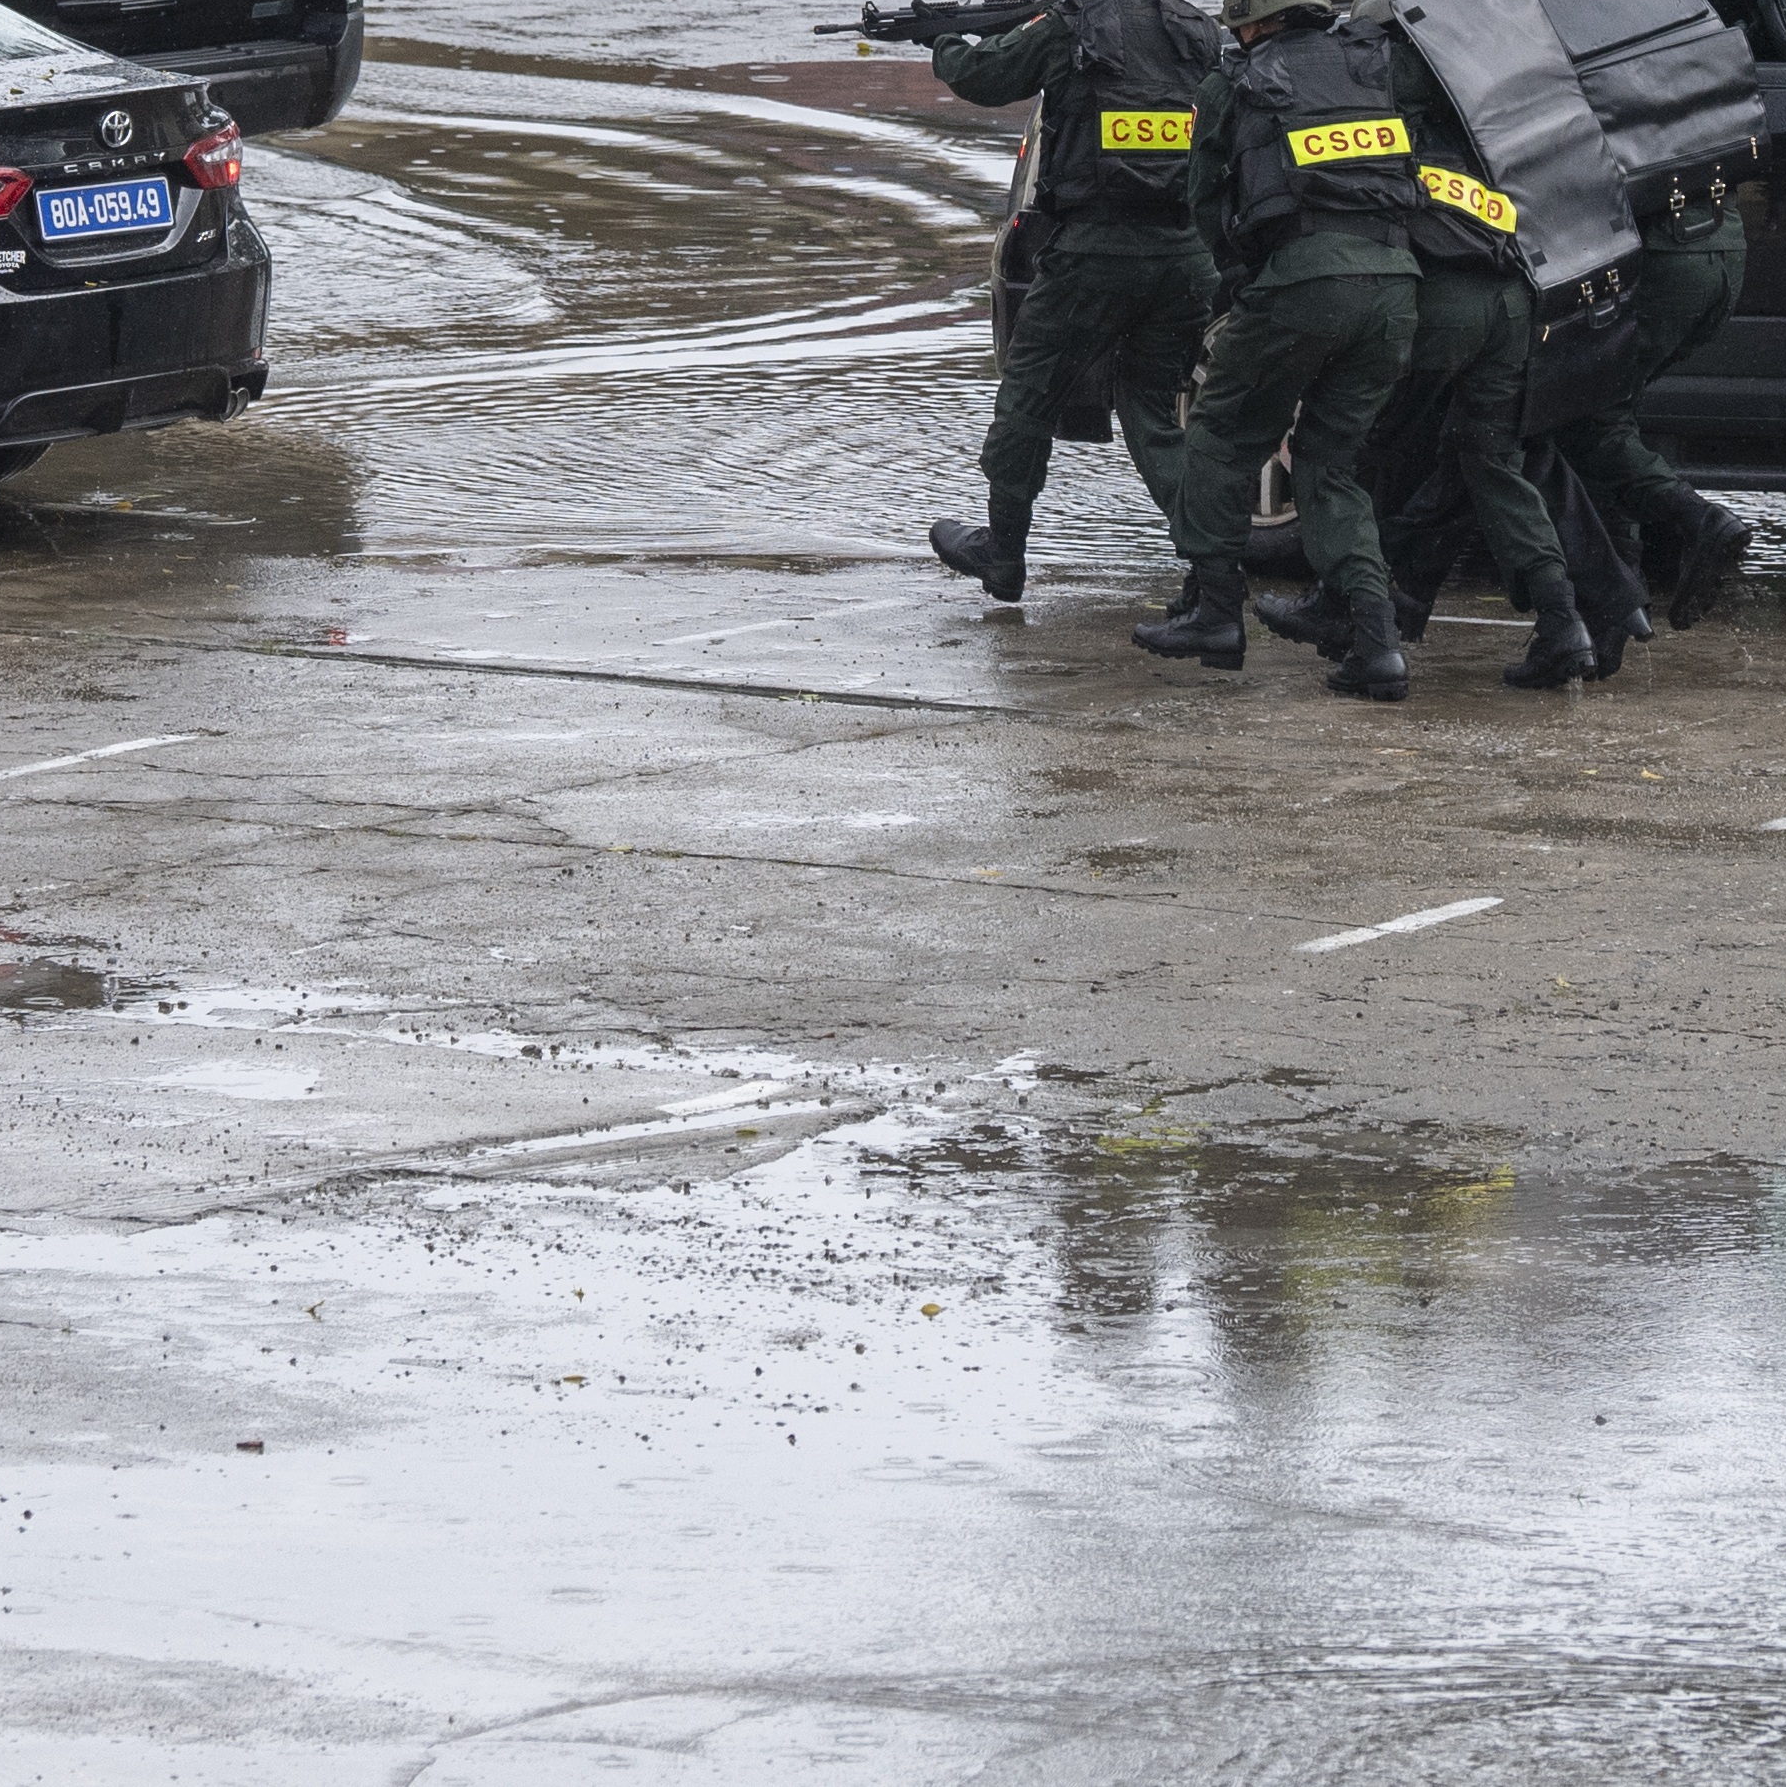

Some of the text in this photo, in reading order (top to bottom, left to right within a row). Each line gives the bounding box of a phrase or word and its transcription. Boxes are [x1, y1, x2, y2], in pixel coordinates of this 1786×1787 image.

[1304, 126, 1396, 156] CSCĐ
[63, 152, 166, 174] CAMRY
[1422, 172, 1503, 221] CSCĐ
